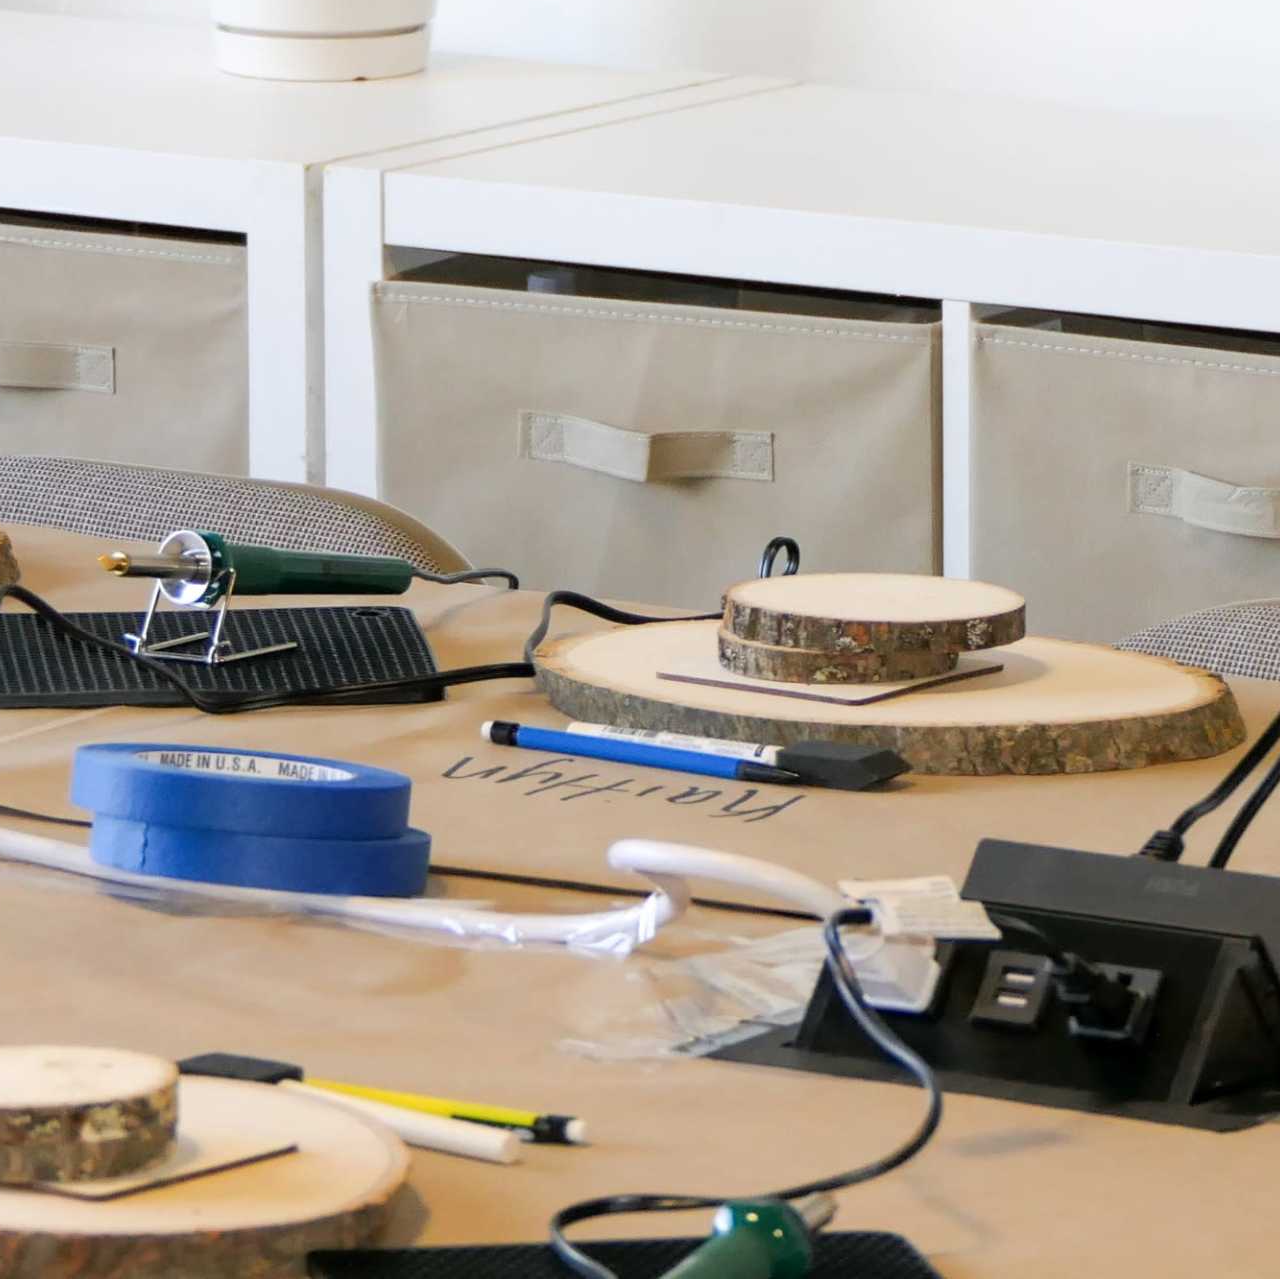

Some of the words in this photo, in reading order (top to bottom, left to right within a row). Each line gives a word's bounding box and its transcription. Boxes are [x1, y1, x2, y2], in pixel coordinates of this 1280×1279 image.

[159, 752, 193, 770] MADE
[196, 754, 212, 770] IN
[215, 756, 261, 775] U.S.A.
[277, 761, 314, 782] MADE
